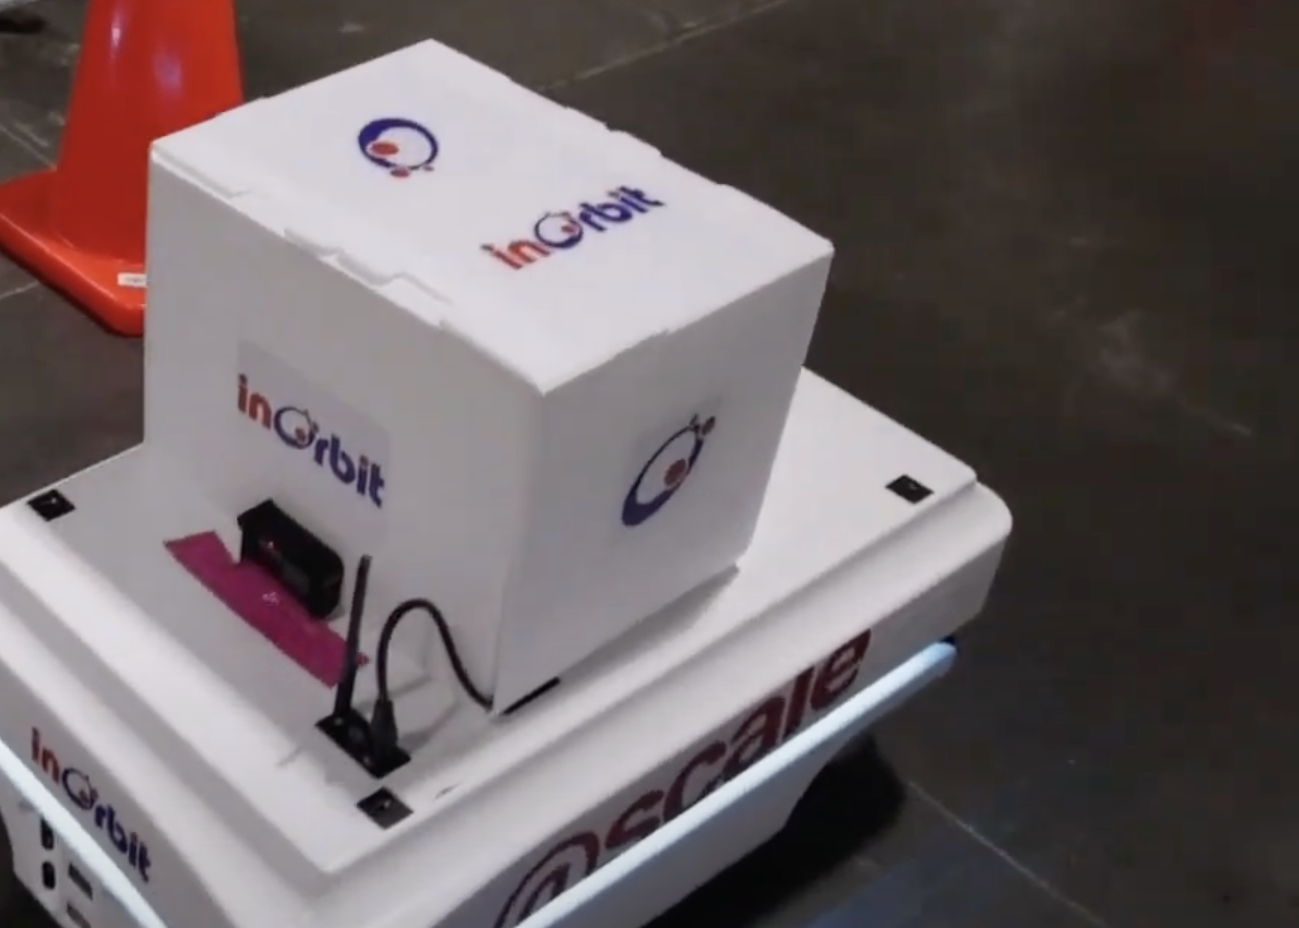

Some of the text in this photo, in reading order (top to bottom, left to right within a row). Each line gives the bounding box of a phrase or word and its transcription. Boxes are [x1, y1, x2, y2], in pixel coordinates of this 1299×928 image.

[480, 185, 664, 270] inOrbit
[236, 374, 386, 508] inOrbit
[30, 726, 152, 884] inOrbit
